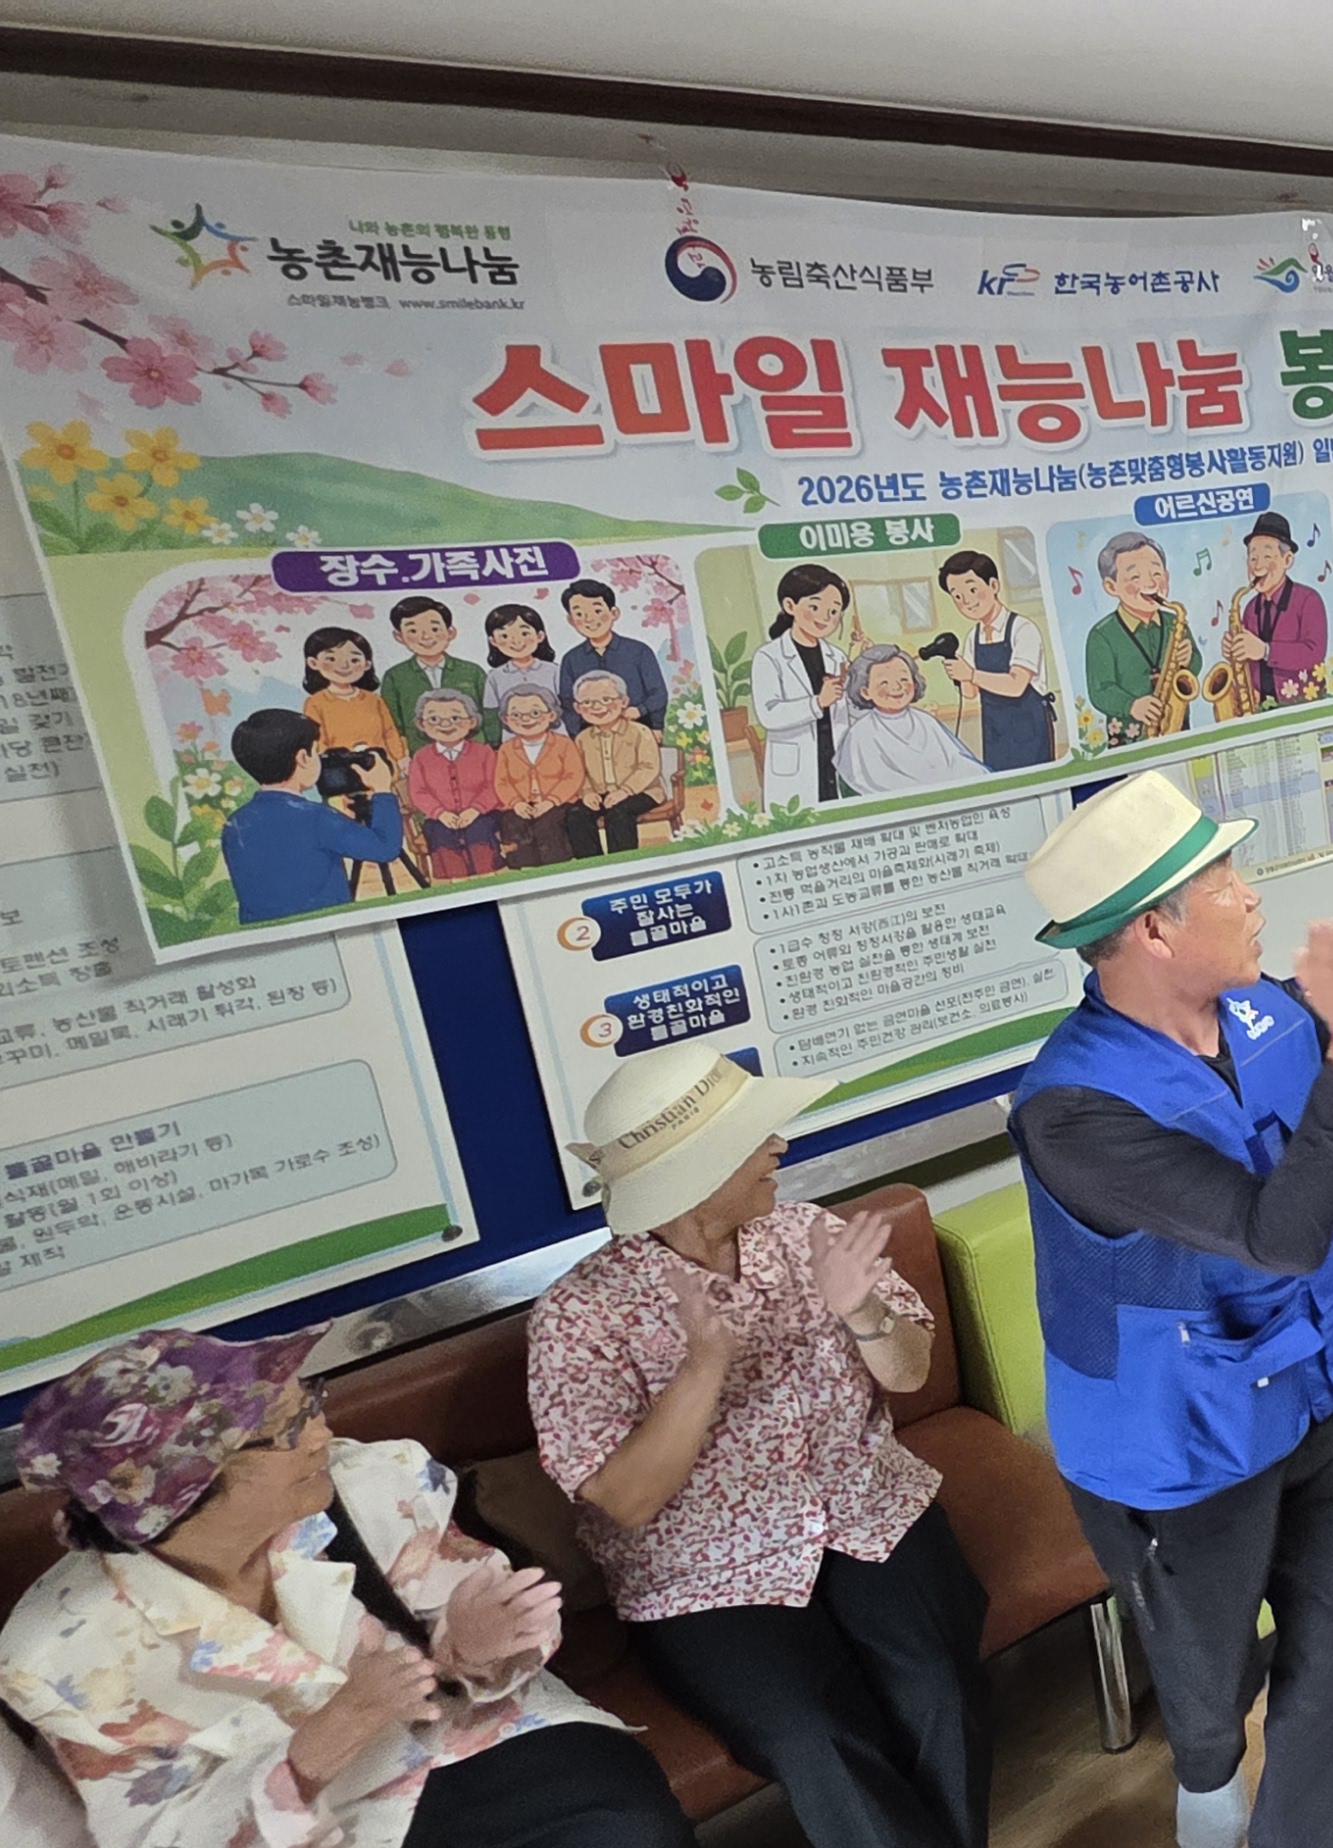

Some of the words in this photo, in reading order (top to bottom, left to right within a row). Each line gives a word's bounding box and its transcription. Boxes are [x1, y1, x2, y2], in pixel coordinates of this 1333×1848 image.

[267, 238, 520, 286] 농촌재능나눔
[750, 258, 934, 294] 농림축산식품부
[1054, 270, 1220, 296] 한국농어촌공사
[472, 336, 853, 452] 스마일
[882, 336, 1245, 444] 재능나눔
[798, 471, 925, 507] 2026년도
[939, 438, 1304, 498] 농촌재능나눔(농촌맞춤형봉사활동지원)
[1155, 489, 1256, 520] 어르신공연
[800, 521, 876, 550] 이미용
[886, 517, 935, 546] 봉사
[319, 546, 549, 586] 장수.가족사진
[763, 850, 802, 874] 고소득
[792, 854, 870, 881] 농업생산에서
[610, 894, 648, 914] 주민
[654, 880, 712, 904] 모두가
[800, 871, 865, 897] 먹을거리의
[636, 903, 694, 927] 잘사는
[576, 926, 590, 941] 2
[126, 990, 188, 1014] 직거래
[632, 974, 728, 1010] 생태적이고
[788, 976, 853, 1006] 생태적이고
[627, 988, 740, 1030] 환경친화적인
[598, 1022, 612, 1037] 3
[617, 1094, 697, 1149] Christian
[694, 1066, 724, 1097] Dior
